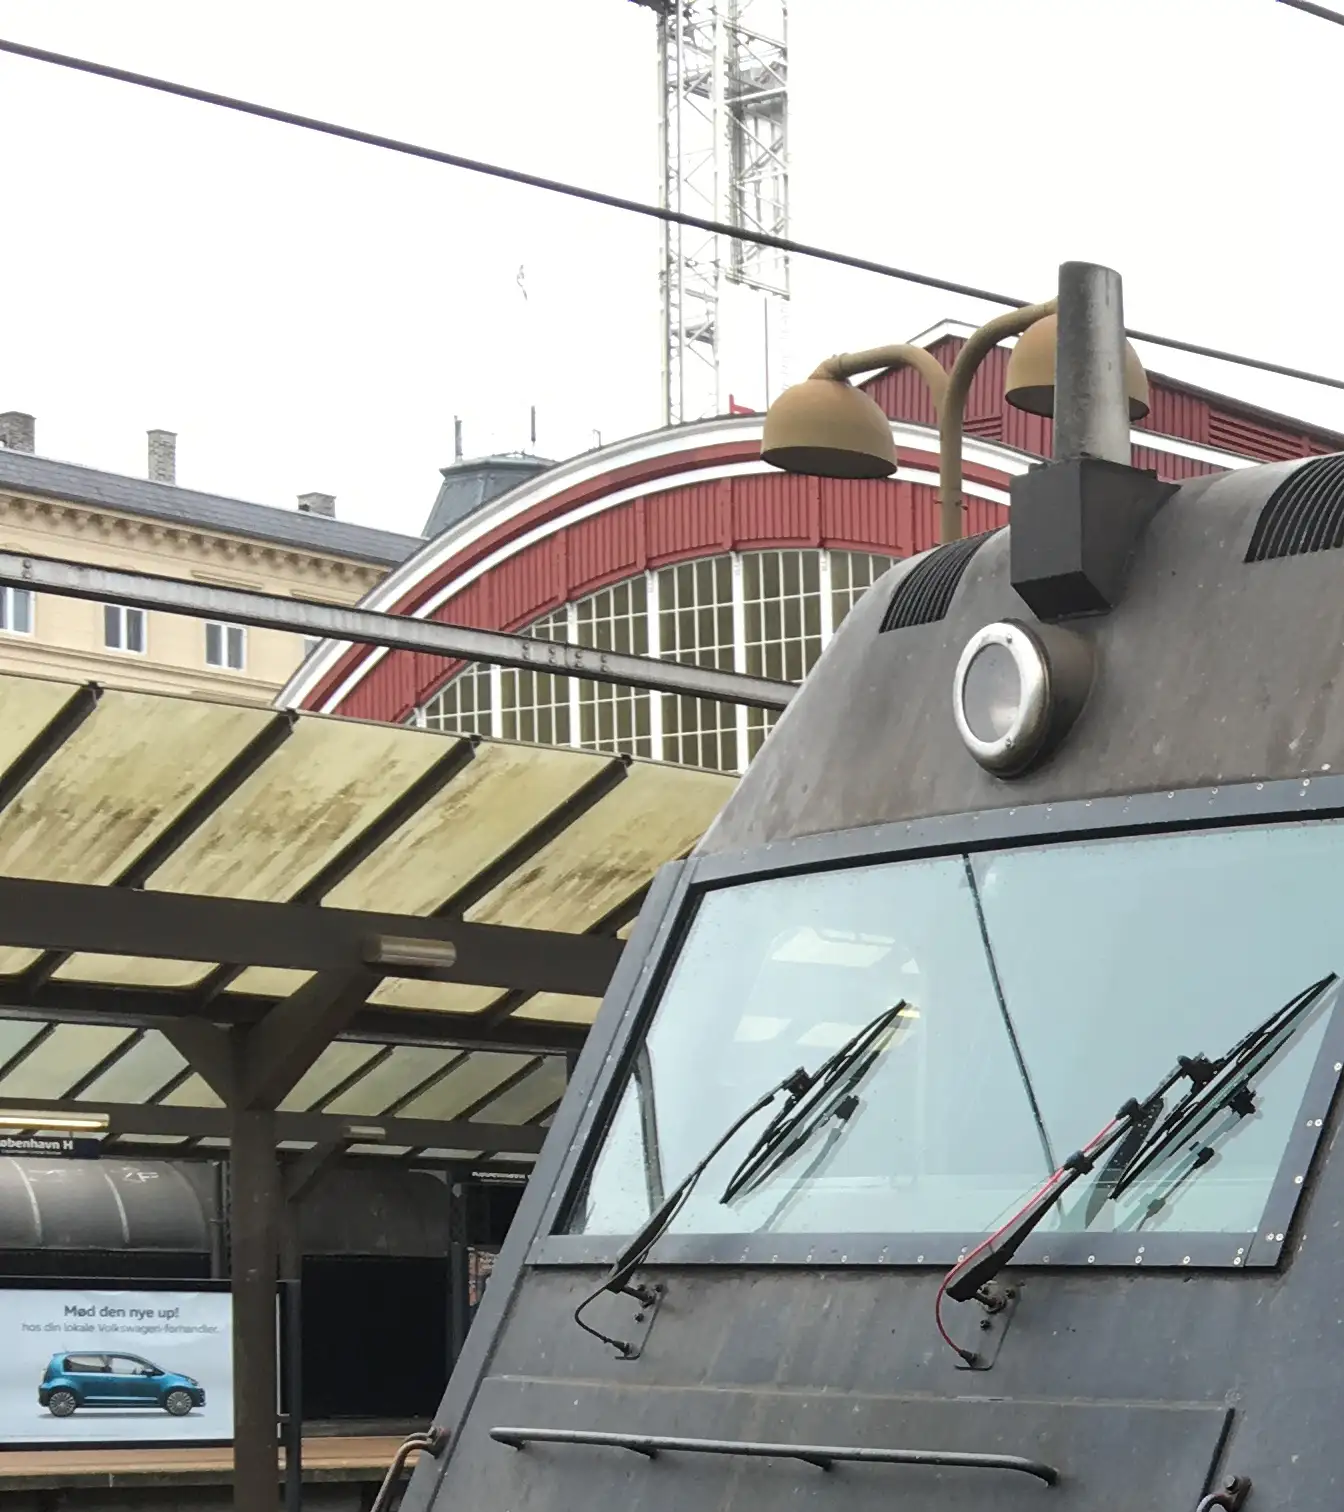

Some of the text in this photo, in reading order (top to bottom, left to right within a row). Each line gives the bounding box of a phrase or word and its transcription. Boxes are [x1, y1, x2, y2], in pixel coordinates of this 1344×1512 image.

[64, 1305, 180, 1321] Mød den nye up!
